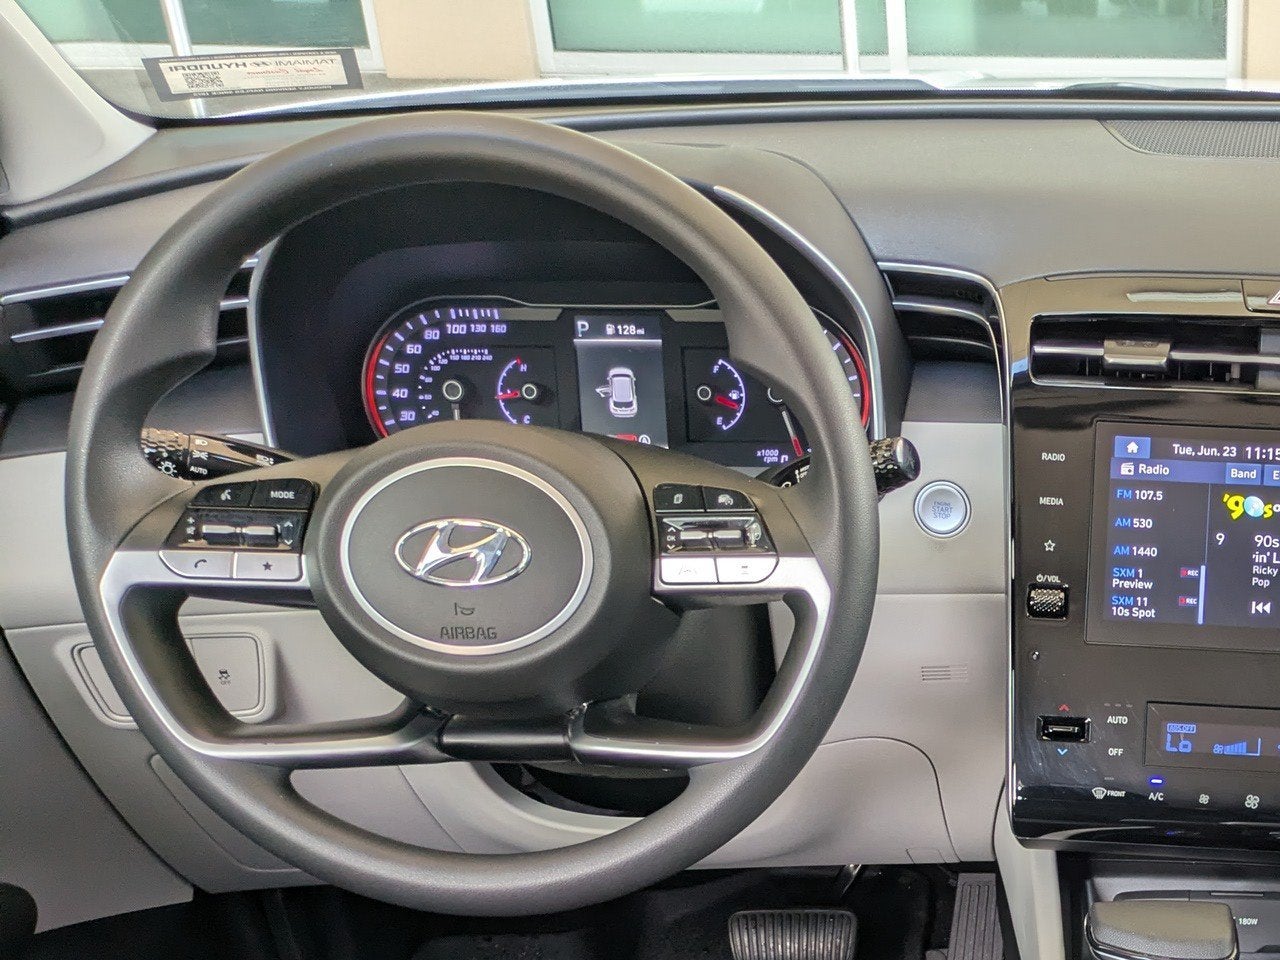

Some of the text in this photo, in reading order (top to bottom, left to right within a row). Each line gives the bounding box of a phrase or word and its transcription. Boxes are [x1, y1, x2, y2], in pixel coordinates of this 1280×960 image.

[446, 324, 467, 335] 100
[470, 324, 487, 334] 130
[490, 324, 507, 334] 160
[576, 321, 589, 337] P
[424, 330, 440, 341] 80
[406, 344, 422, 354] 60
[394, 363, 410, 374] 50
[520, 364, 528, 373] H
[392, 388, 408, 399] 40
[400, 411, 416, 421] 30
[716, 417, 723, 426] E
[756, 449, 779, 457] x1000
[1172, 444, 1195, 457] Tue,
[1197, 445, 1220, 457] Jun.
[1223, 446, 1237, 457] 23
[763, 456, 779, 464] rpm
[1041, 452, 1066, 462] RADIO
[189, 466, 208, 475] AUTO
[1138, 463, 1170, 476] Radio
[1230, 468, 1257, 480] Band
[270, 490, 295, 500] MODE
[1116, 489, 1163, 501] FM 107.5
[1039, 496, 1064, 506] MEDIA
[1114, 518, 1153, 529] AM 530
[1215, 532, 1225, 546] 9
[1254, 535, 1280, 548] 90s
[1113, 546, 1158, 557] AM 1440
[1113, 567, 1143, 578] SXM 1
[1253, 566, 1278, 577] Ricky
[1112, 579, 1154, 589] Preview
[1252, 577, 1271, 588] Pop
[1111, 596, 1148, 607] SXM 11
[1112, 607, 1156, 619] 10s Spot
[440, 626, 498, 640] AIRBAG
[1106, 715, 1129, 725] AUTO
[1108, 747, 1124, 757] OFF
[1107, 789, 1126, 798] FRONT
[1148, 792, 1164, 802] A/C
[1238, 917, 1259, 926] 180W
